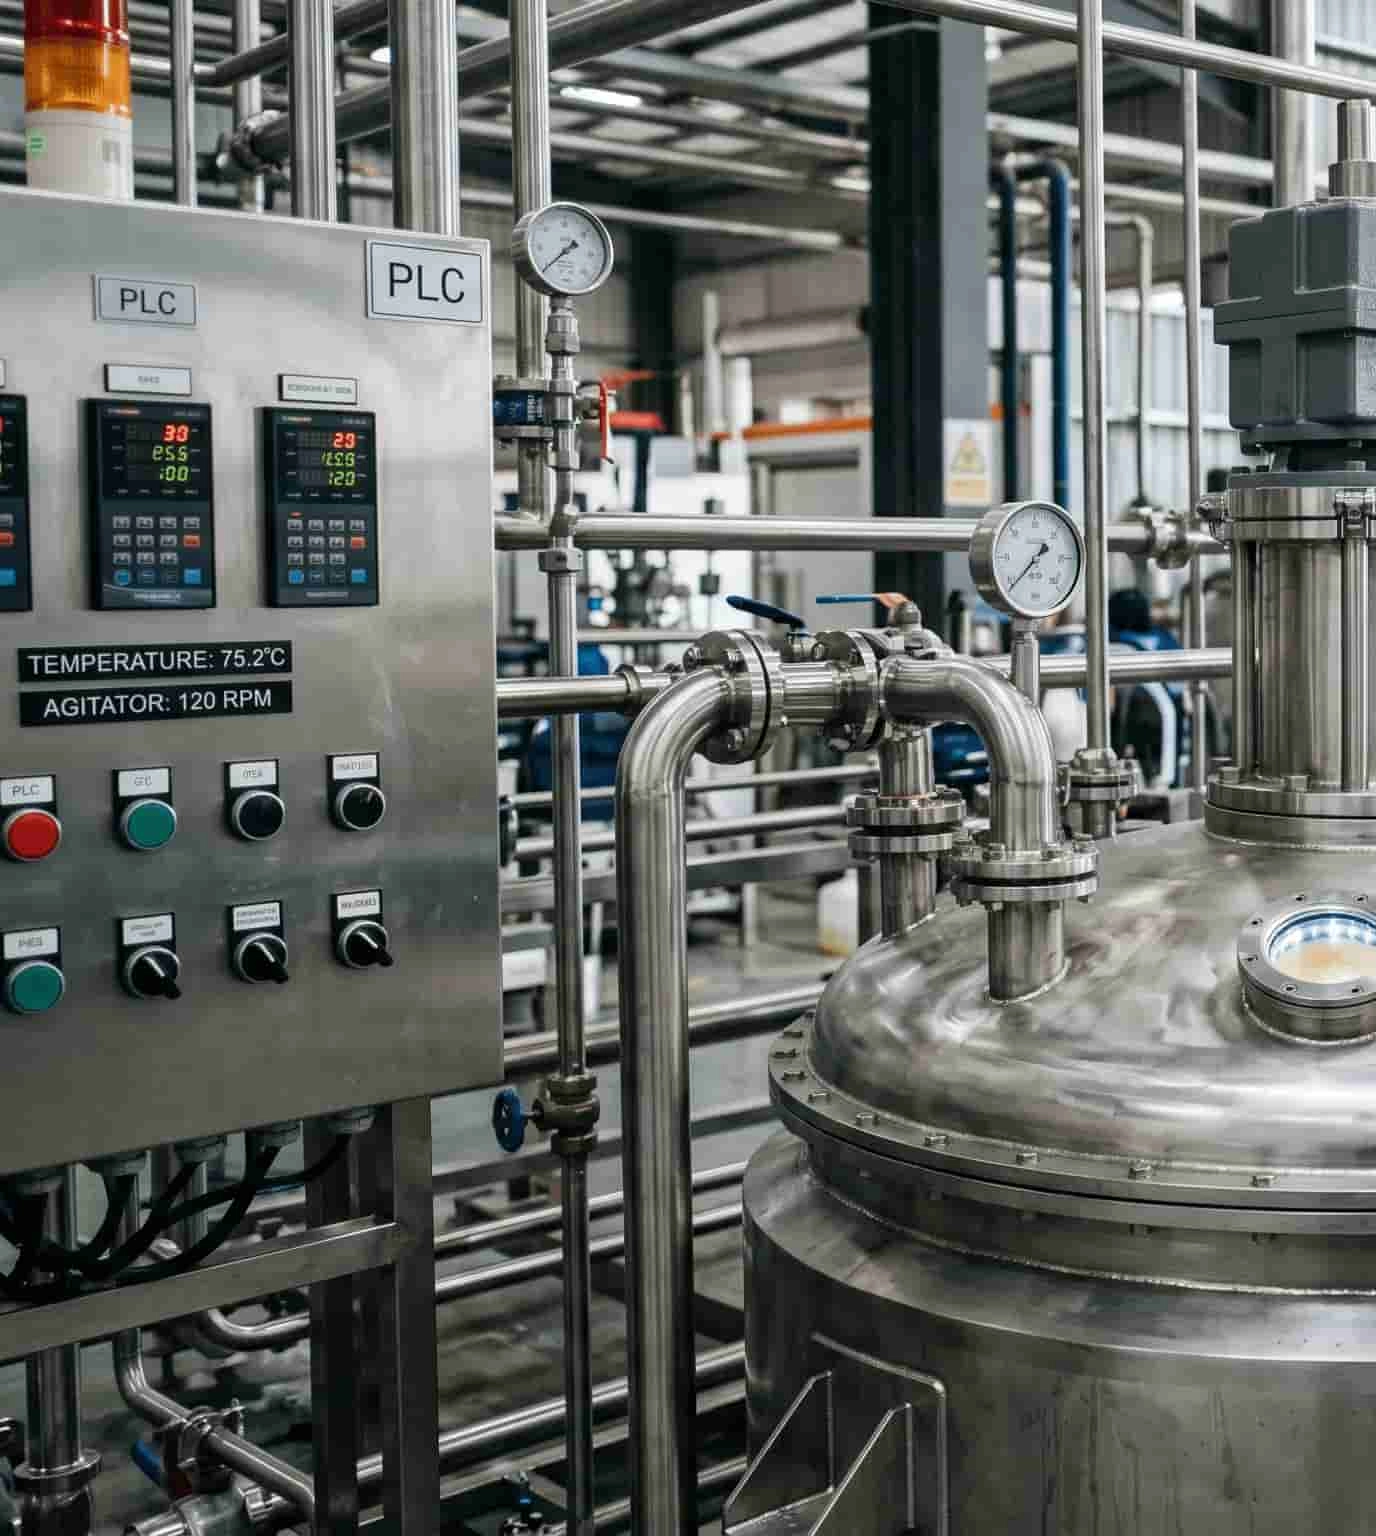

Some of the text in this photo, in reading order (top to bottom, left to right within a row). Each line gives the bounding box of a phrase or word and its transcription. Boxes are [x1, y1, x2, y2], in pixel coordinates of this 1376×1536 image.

[389, 262, 465, 304] PLC
[120, 287, 176, 316] PLC
[27, 647, 286, 675] TEMPERATURE: 75.2°C
[43, 688, 273, 719] AGITATOR: 120 RPM
[11, 784, 41, 798] PLC
